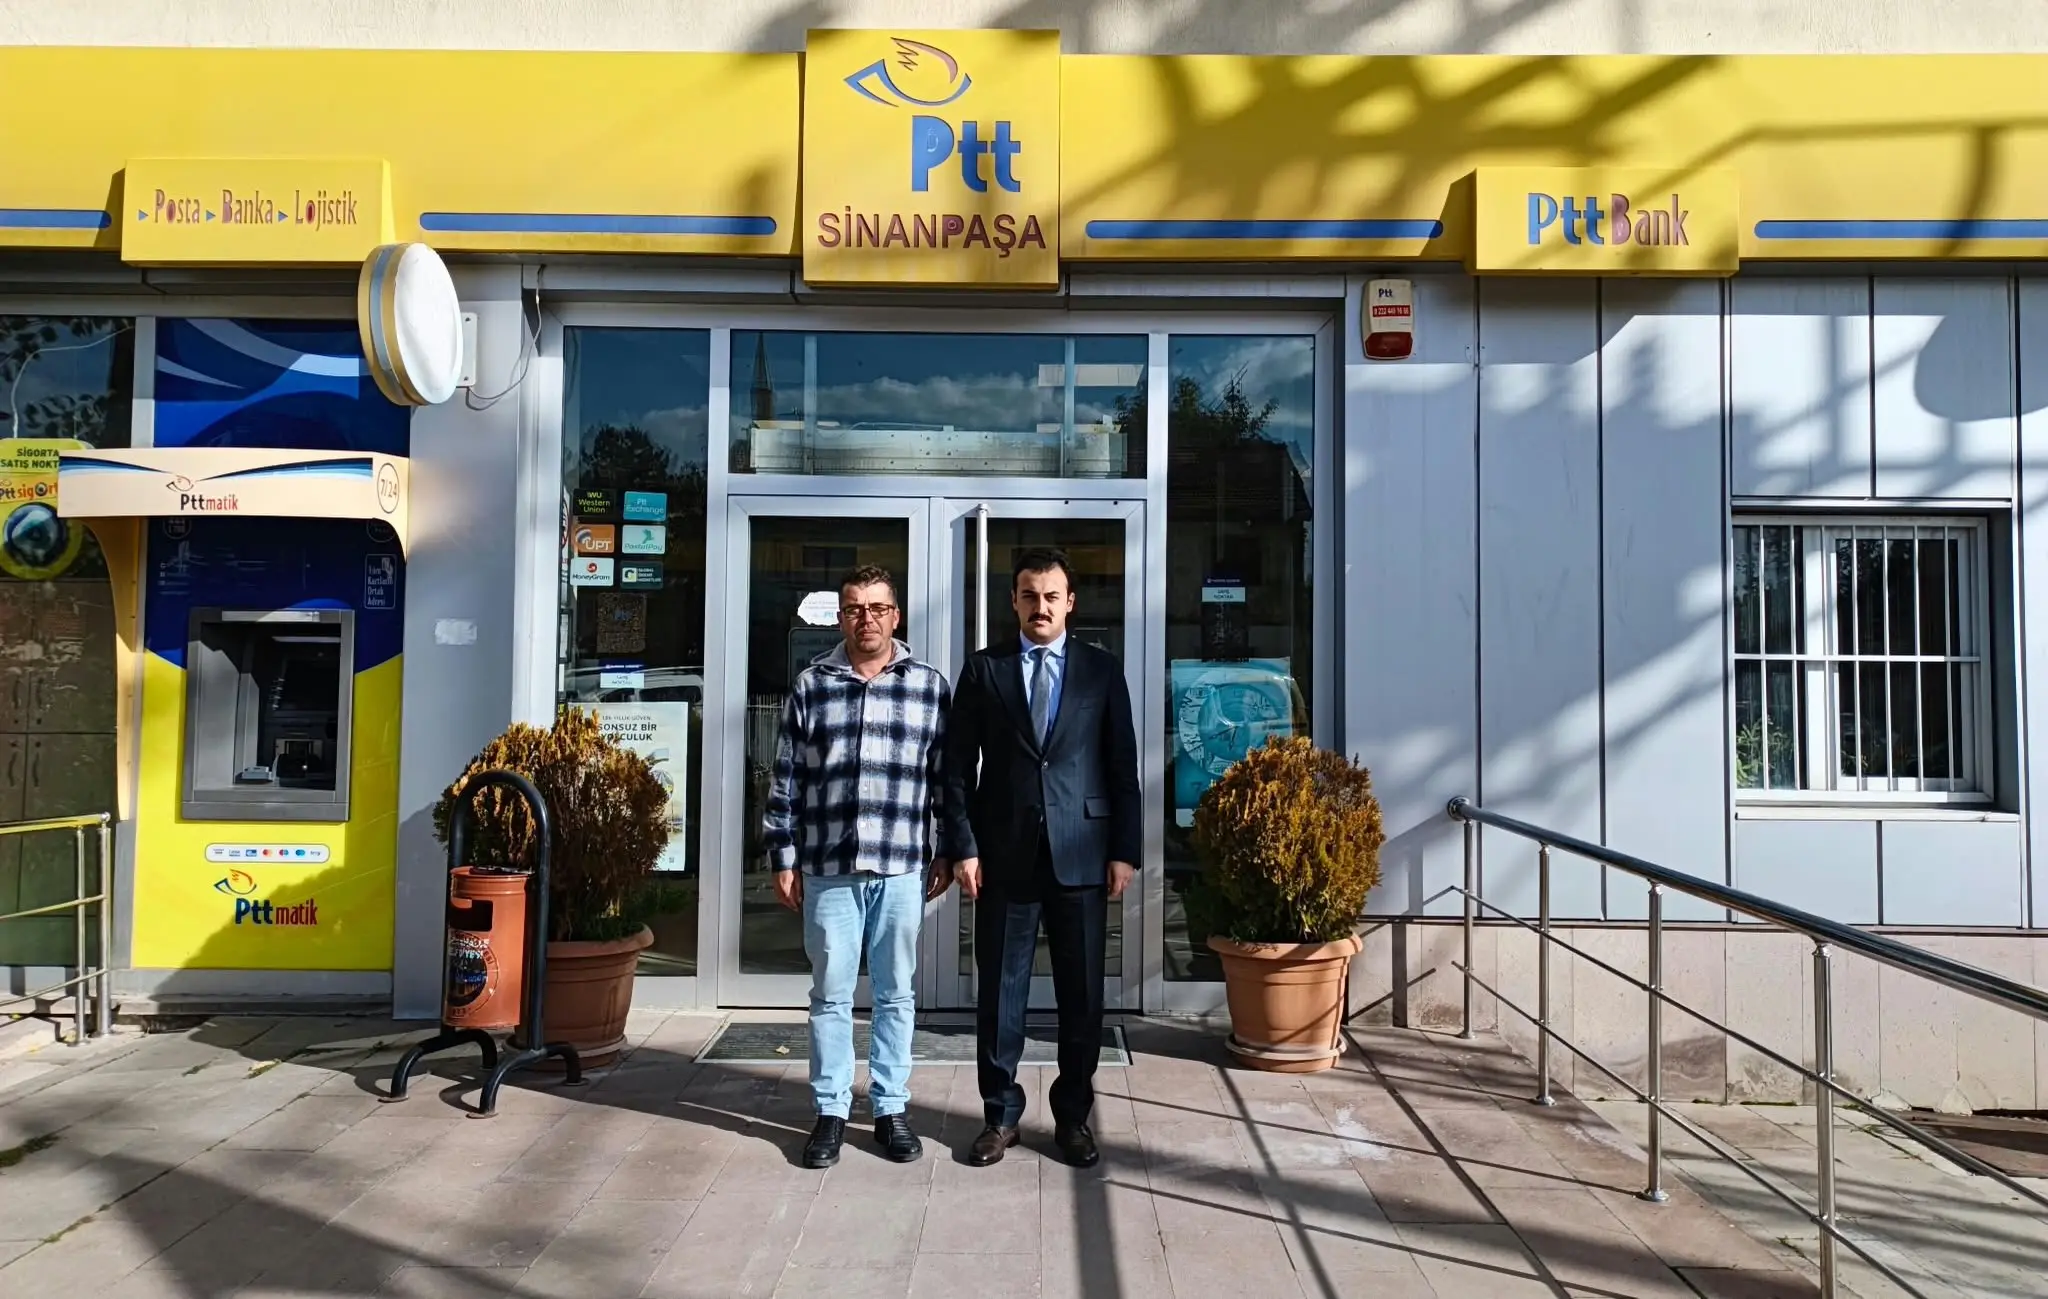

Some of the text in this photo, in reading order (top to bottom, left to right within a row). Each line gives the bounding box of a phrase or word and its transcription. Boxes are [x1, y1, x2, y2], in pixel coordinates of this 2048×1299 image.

[911, 115, 1021, 193] Ptt
[154, 189, 358, 232] Posta Banka Lojistik
[817, 205, 1047, 258] SİNANPAŞA
[1378, 288, 1393, 298] Ptt
[17, 446, 59, 457] SİGORTA
[0, 459, 59, 470] SATIŞ NOKT
[380, 478, 398, 500] 7/24
[578, 498, 611, 507] Western
[583, 506, 606, 514] Union
[626, 504, 665, 515] Exchange
[585, 540, 612, 551] UPT
[572, 573, 611, 581] MoneyGram
[598, 721, 657, 731] SONSUZ BİR
